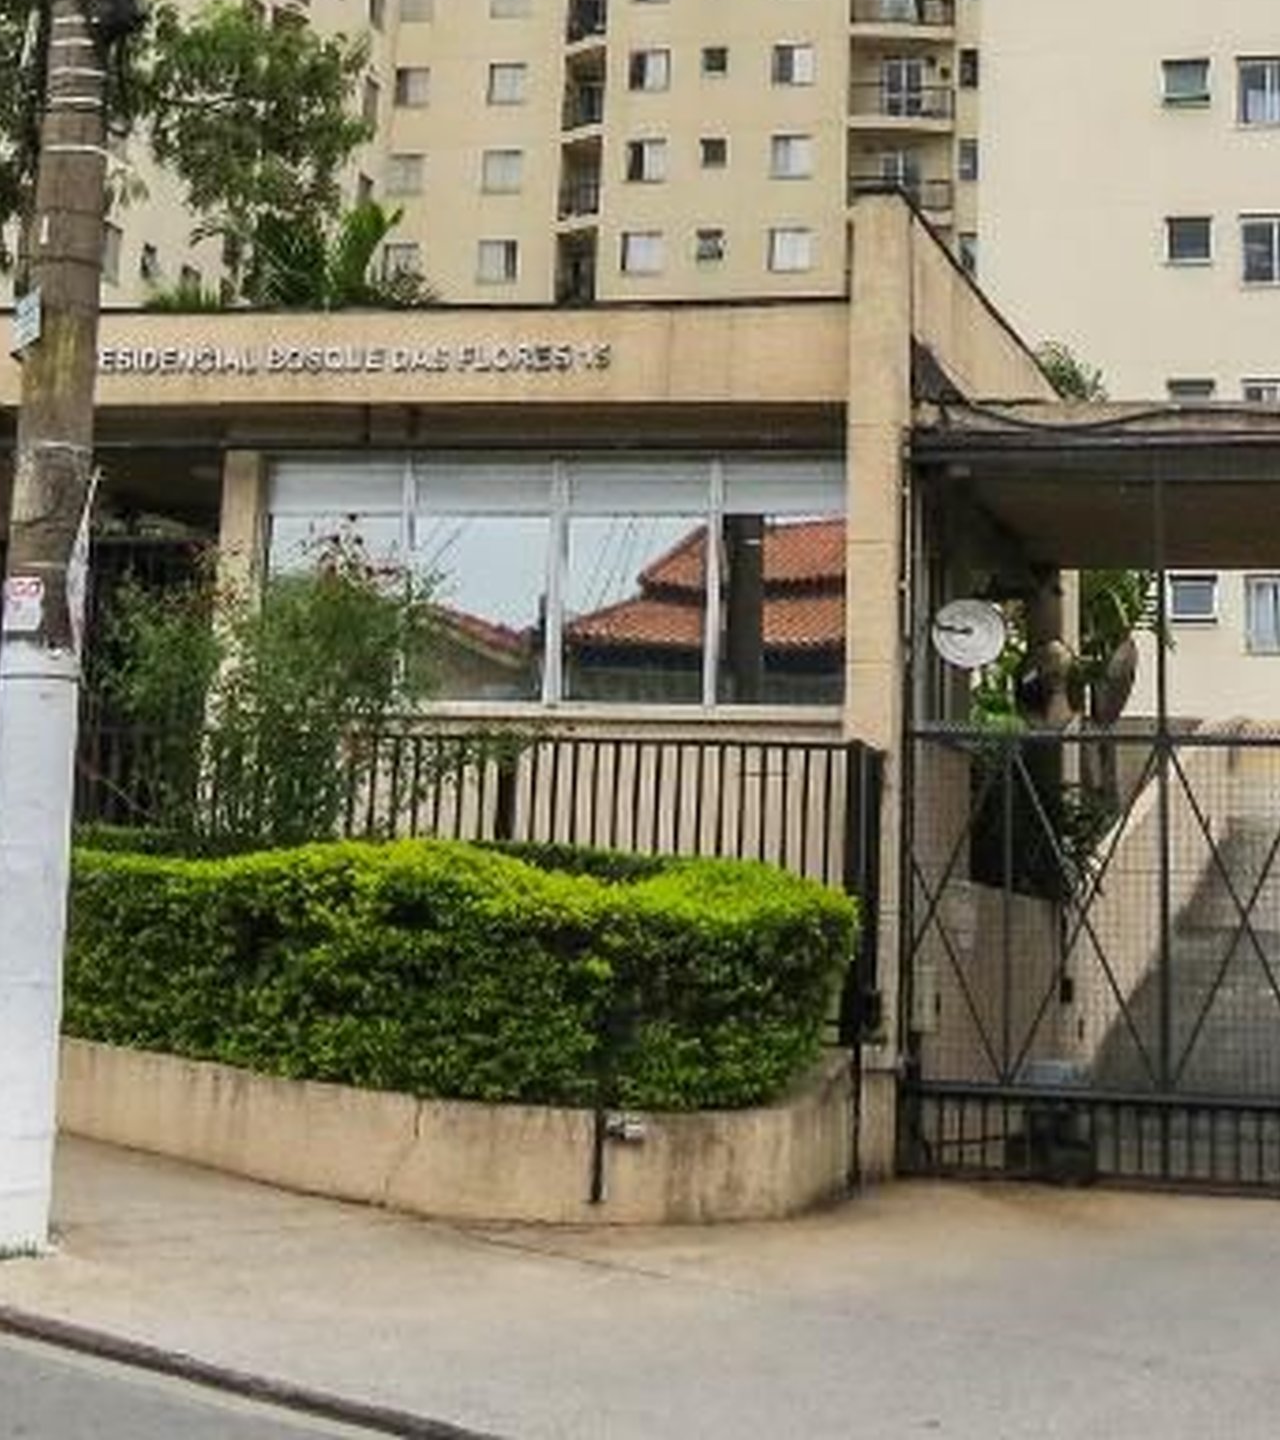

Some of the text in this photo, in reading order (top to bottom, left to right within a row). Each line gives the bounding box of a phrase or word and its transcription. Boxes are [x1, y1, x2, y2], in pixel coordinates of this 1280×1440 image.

[93, 345, 259, 375] ESIDENCIAL
[267, 344, 388, 375] BOSQUE
[389, 343, 450, 373] DAS
[457, 343, 575, 373] FLORES
